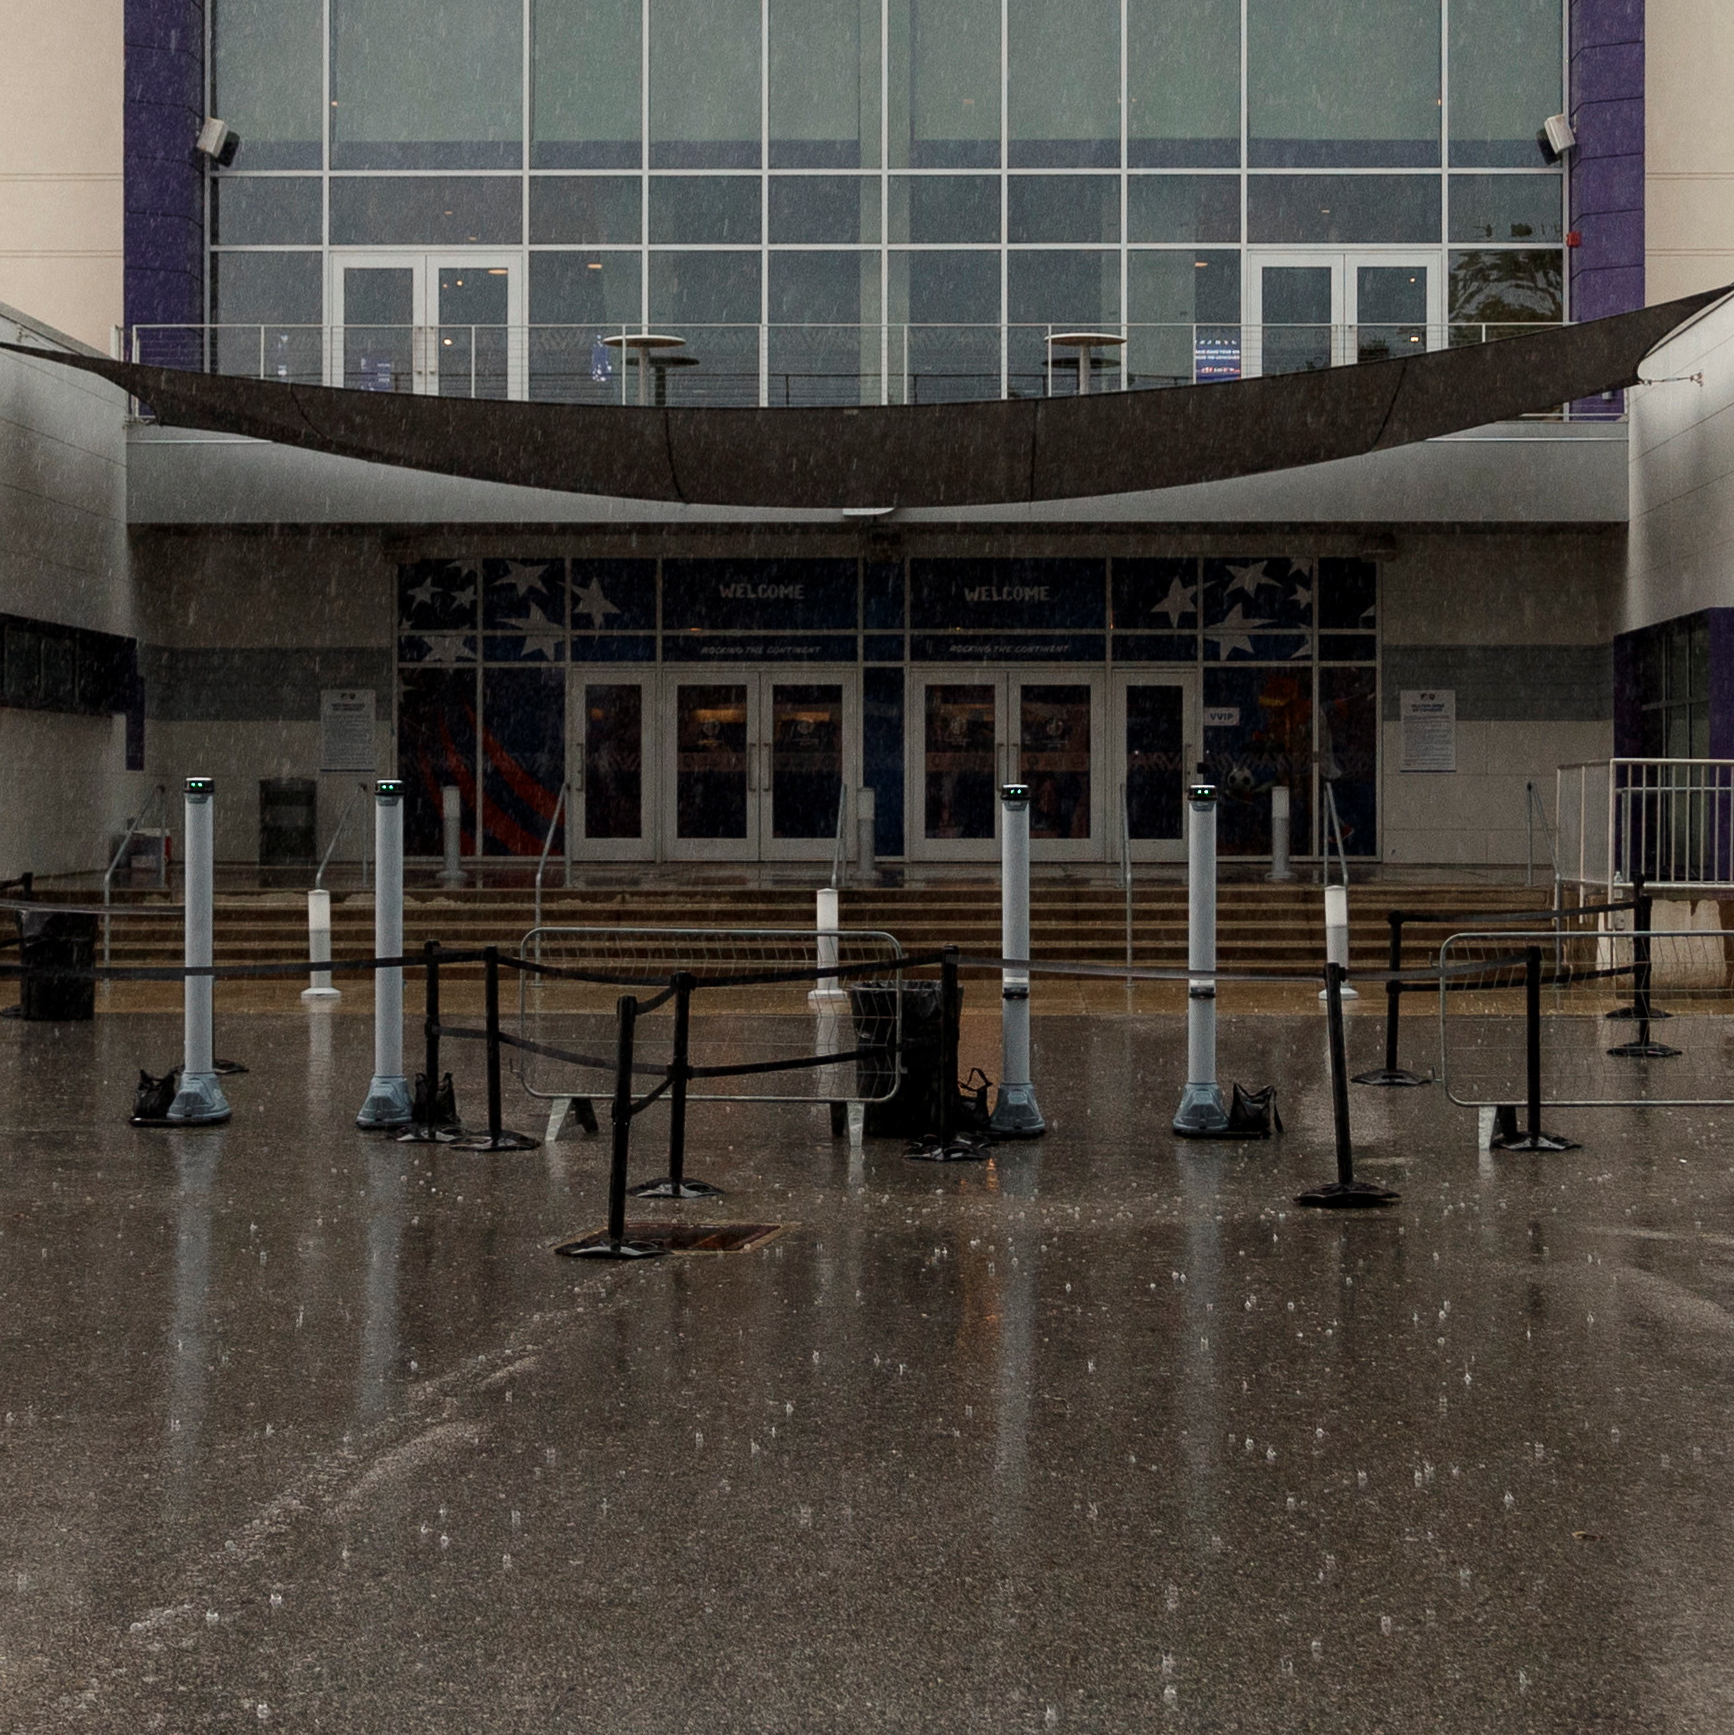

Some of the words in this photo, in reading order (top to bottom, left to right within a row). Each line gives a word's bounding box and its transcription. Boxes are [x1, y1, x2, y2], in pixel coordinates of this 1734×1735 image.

[718, 583, 806, 600] WELCOME
[963, 585, 1051, 602] WELCOME
[701, 645, 743, 655] ROCKING
[745, 645, 764, 655] THE
[766, 645, 822, 655] CONTINENT
[949, 644, 991, 654] ROCKING
[993, 644, 1011, 654] THE
[1013, 644, 1070, 654] CONTINENT
[1210, 712, 1234, 721] VVIP
